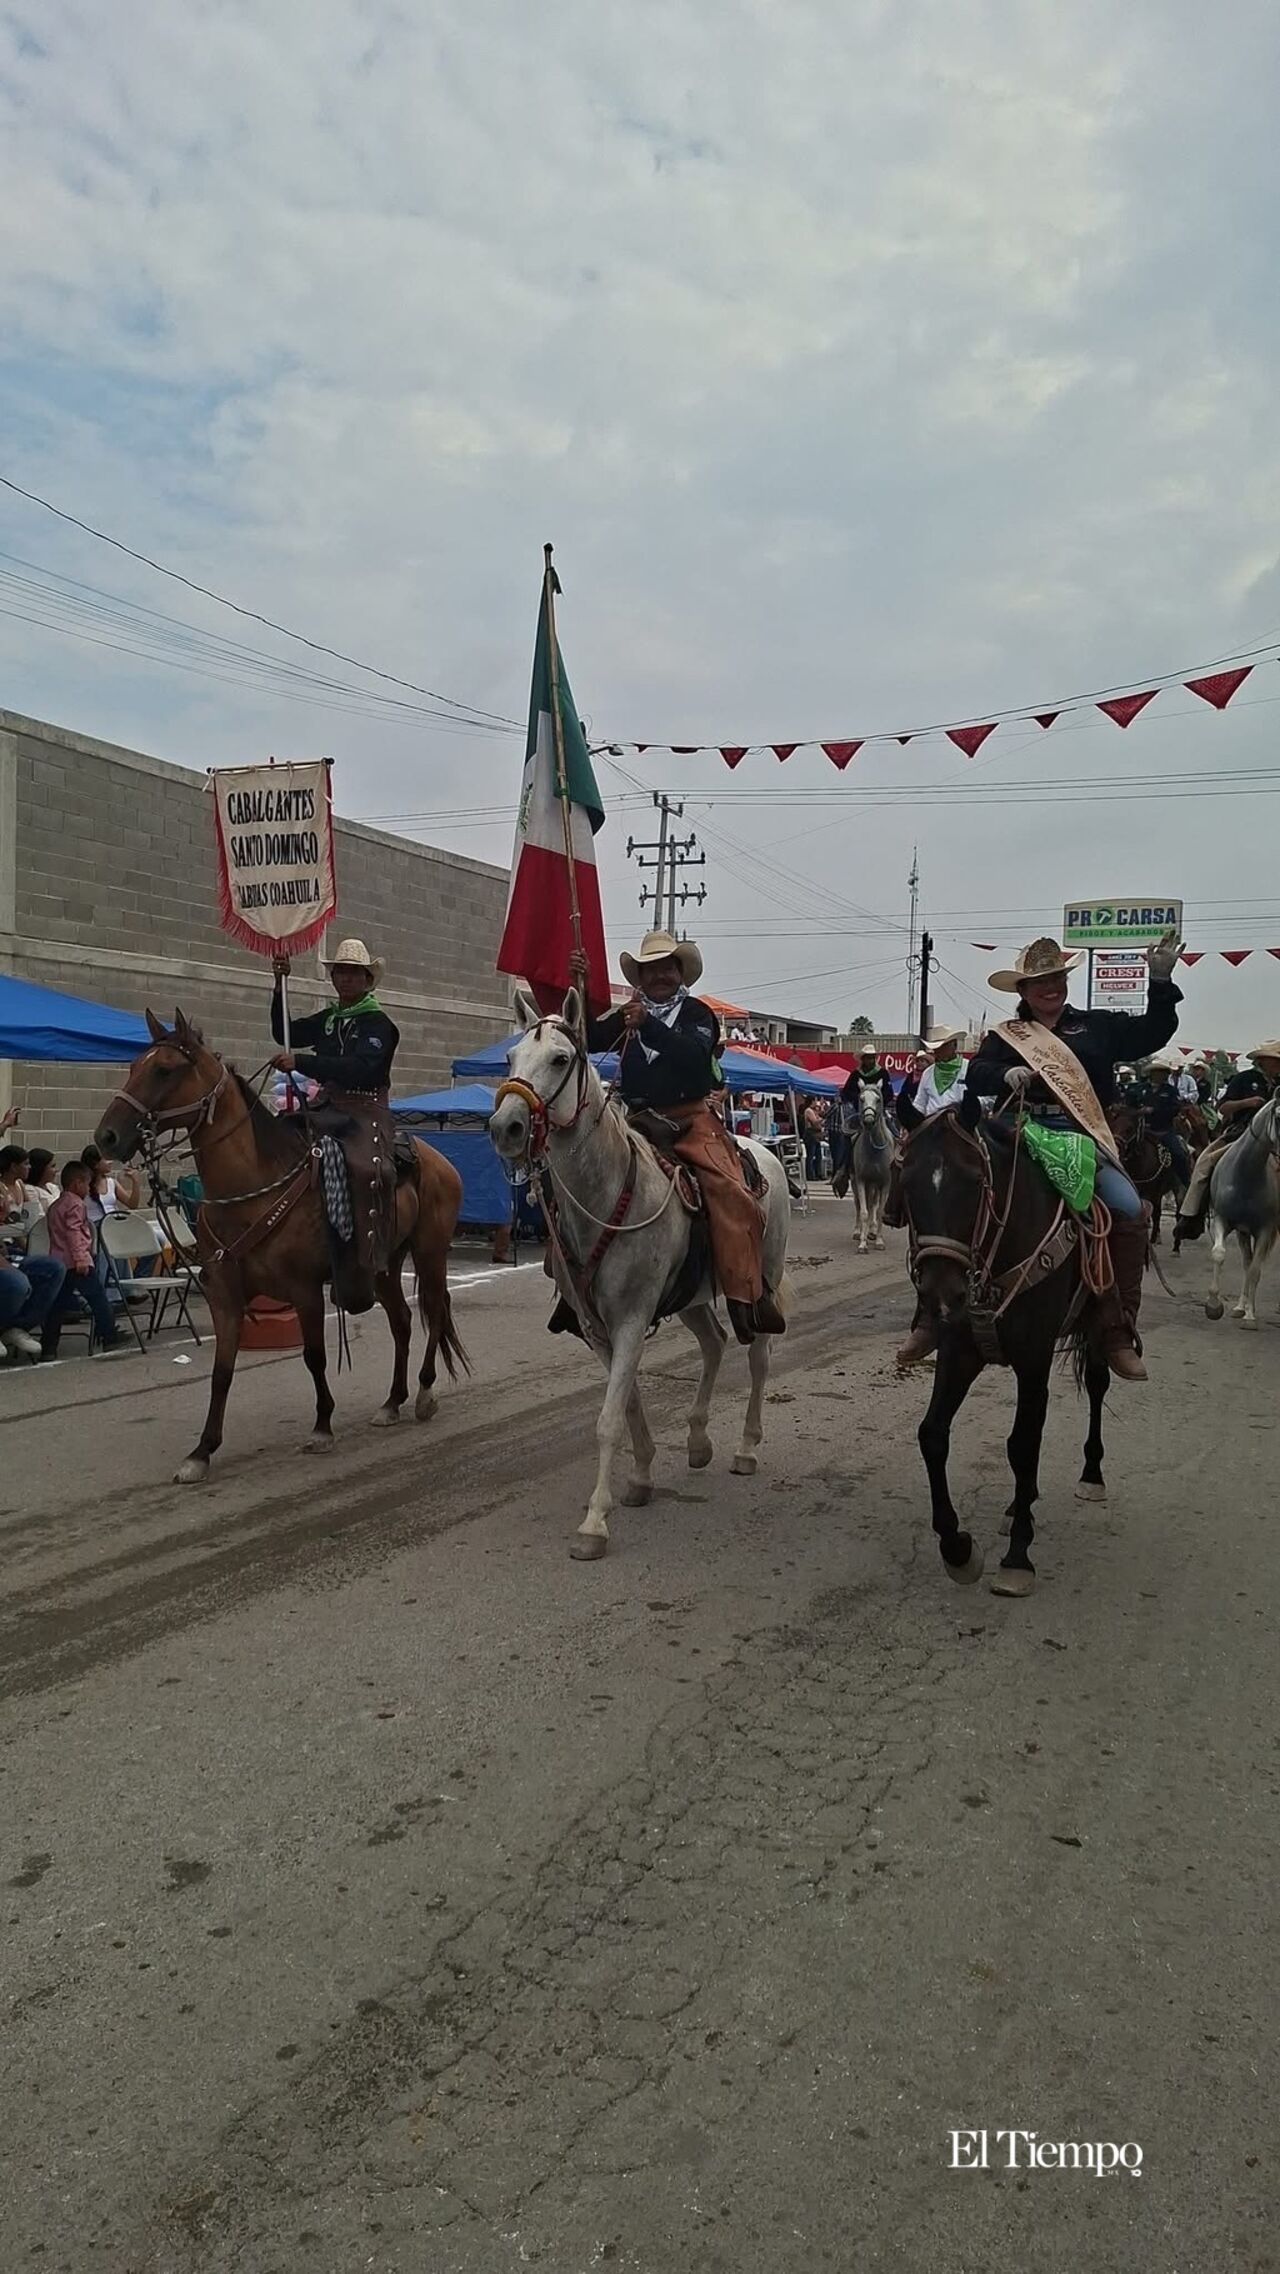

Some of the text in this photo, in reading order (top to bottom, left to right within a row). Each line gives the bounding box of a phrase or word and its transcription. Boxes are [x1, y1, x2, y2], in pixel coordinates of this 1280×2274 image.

[227, 788, 315, 824] CABALGANTES
[230, 831, 319, 868] SANTO DOMINGO
[269, 878, 321, 907] COAHUILA
[1099, 967, 1143, 978] CREST
